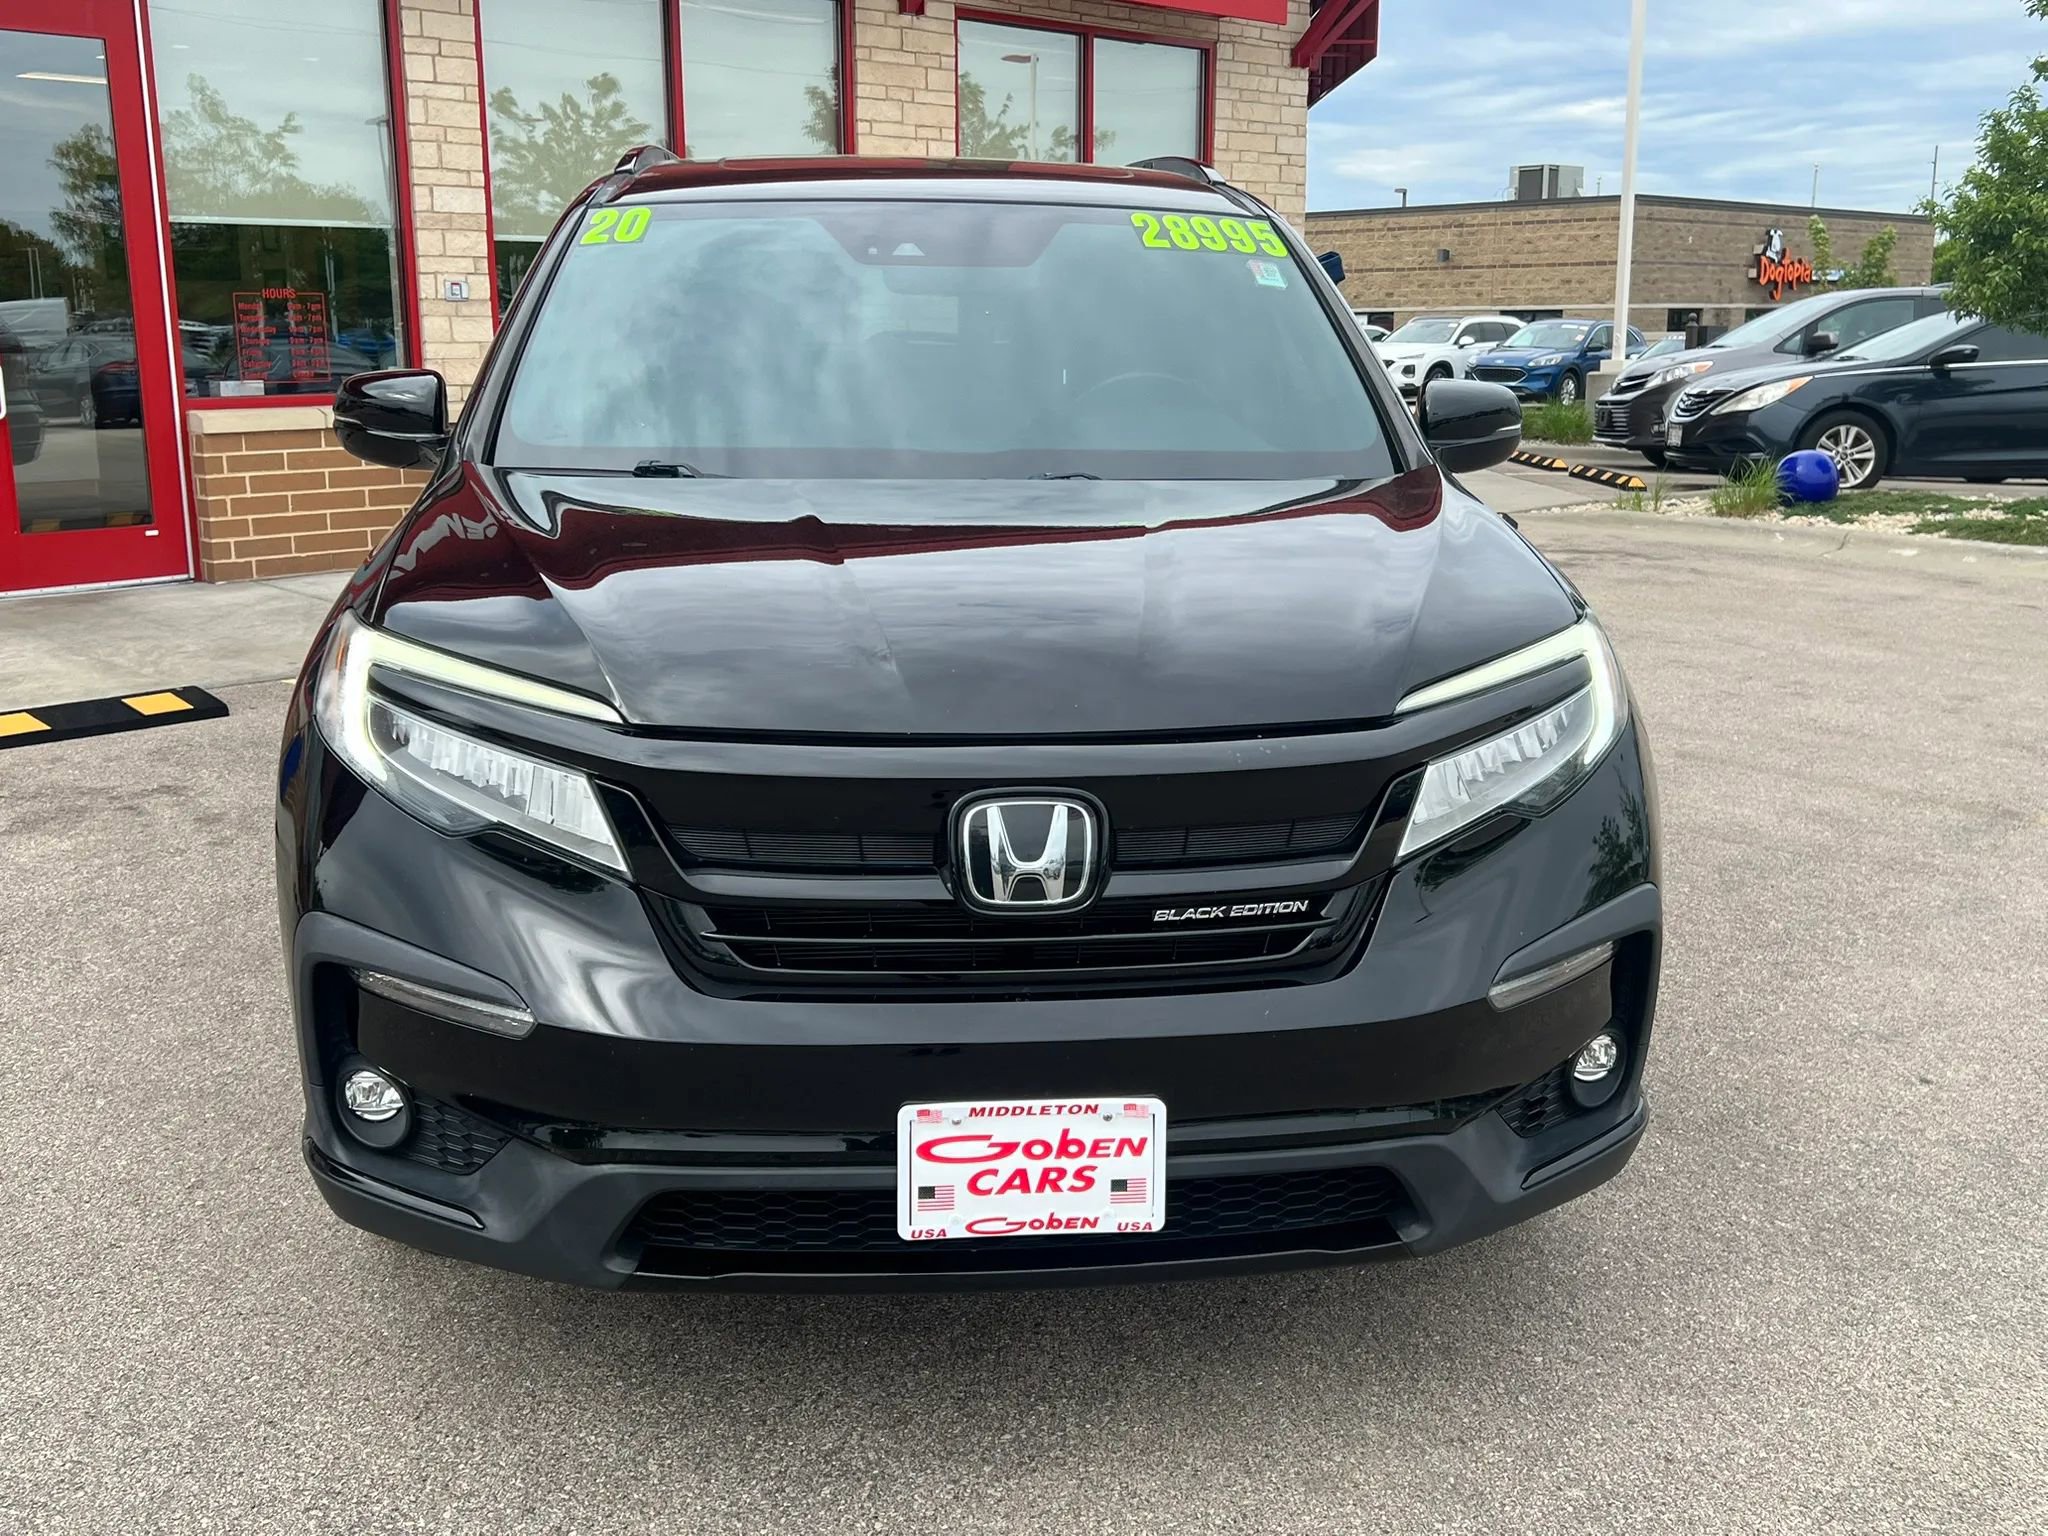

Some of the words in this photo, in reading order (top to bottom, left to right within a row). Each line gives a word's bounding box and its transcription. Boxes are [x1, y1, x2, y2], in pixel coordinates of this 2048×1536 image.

[580, 207, 652, 245] 20
[1130, 212, 1288, 257] 28995
[1760, 247, 1812, 301] Dogtopia
[262, 288, 296, 299] HOURS
[1153, 906, 1227, 922] BLACK
[1229, 900, 1309, 917] EDITION
[968, 1104, 1099, 1117] MIDDLETON
[967, 1165, 1098, 1196] CARS
[911, 1228, 947, 1239] USA
[1117, 1221, 1153, 1232] USA
